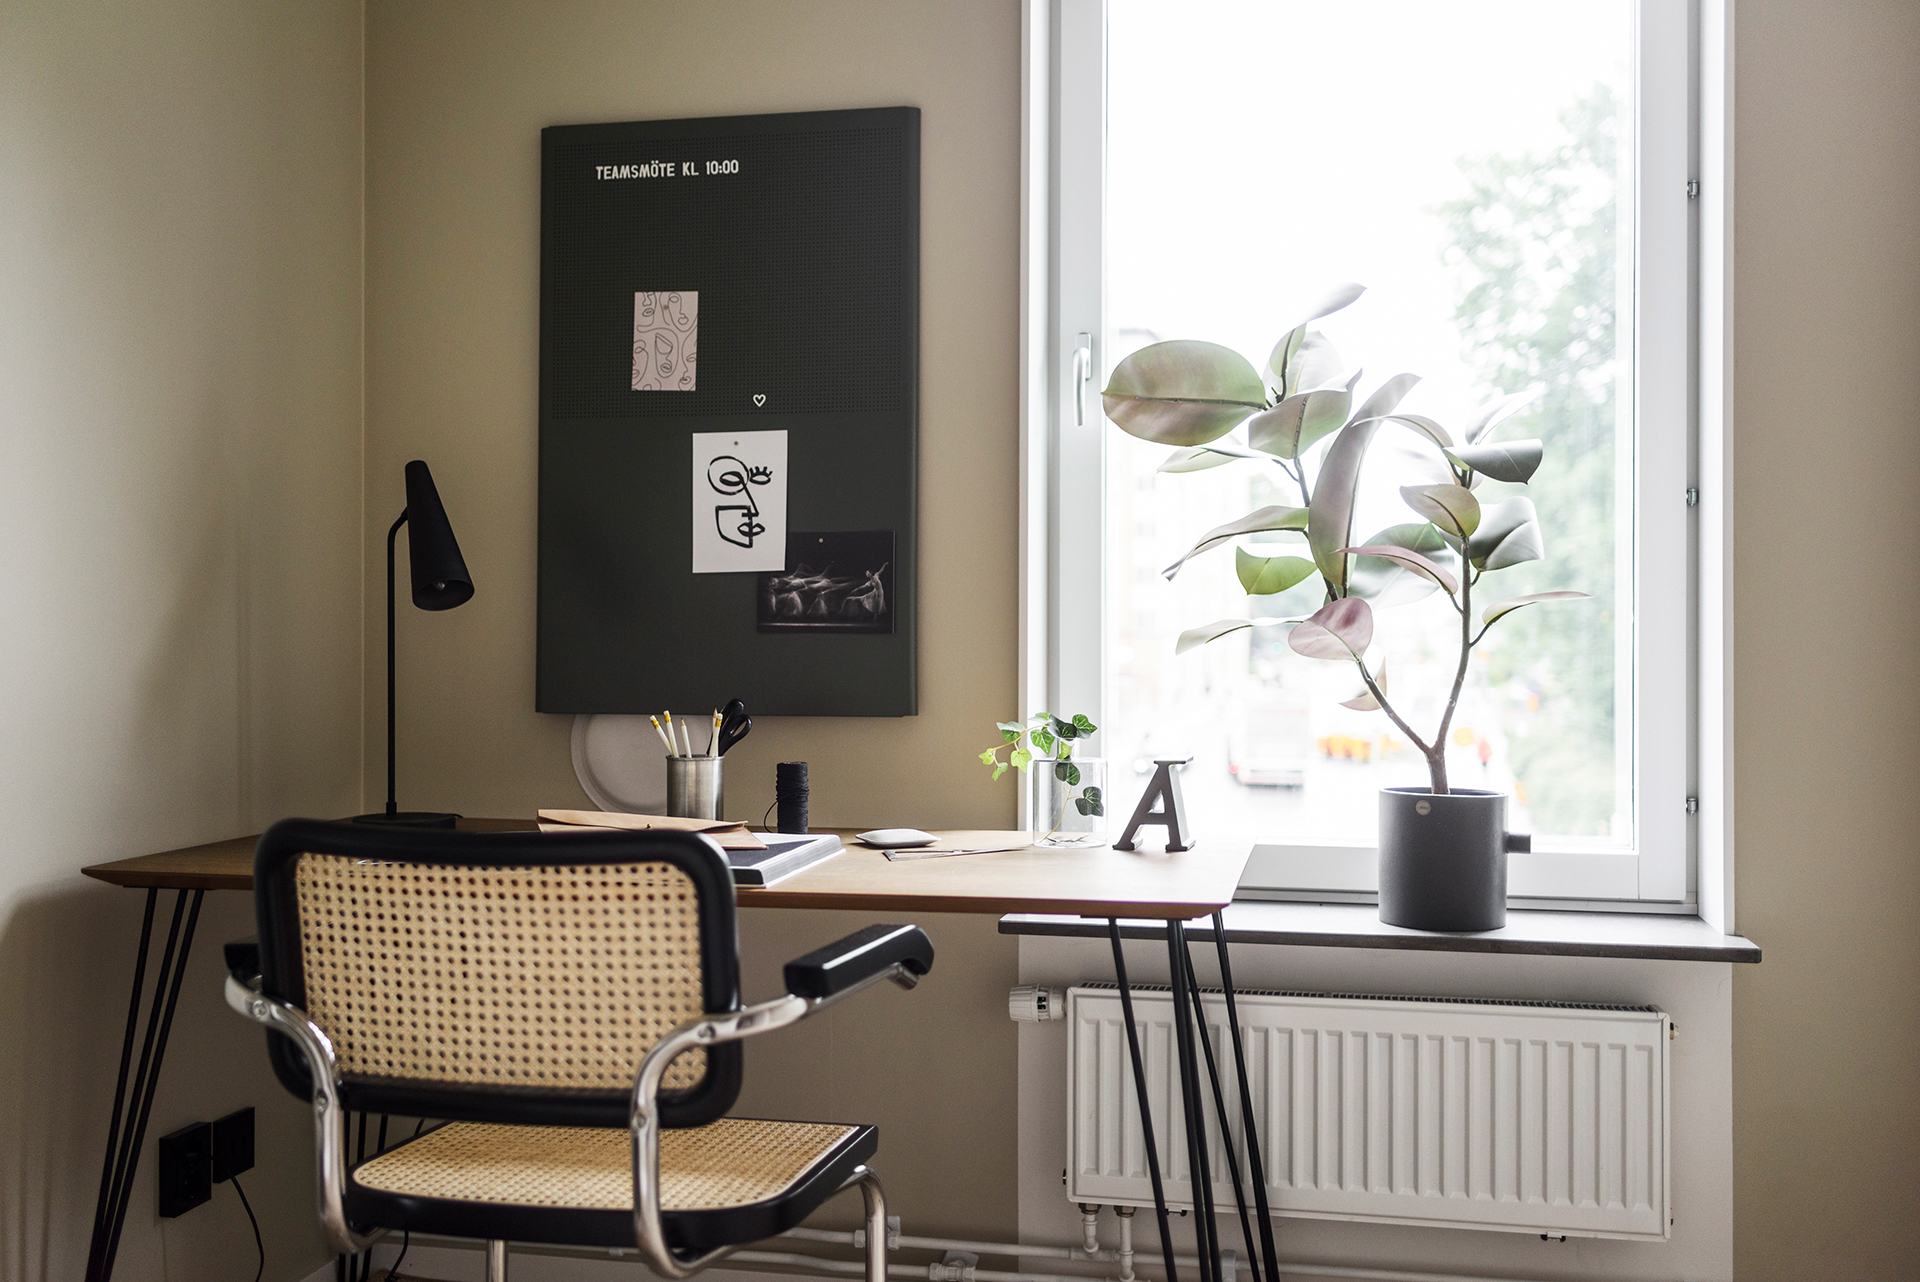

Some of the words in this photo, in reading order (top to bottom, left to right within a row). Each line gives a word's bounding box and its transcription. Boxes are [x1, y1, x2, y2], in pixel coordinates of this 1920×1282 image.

[595, 160, 676, 180] TEAMSMÖTE
[682, 161, 699, 176] KL
[705, 159, 740, 175] 10:00
[1112, 756, 1195, 852] A
